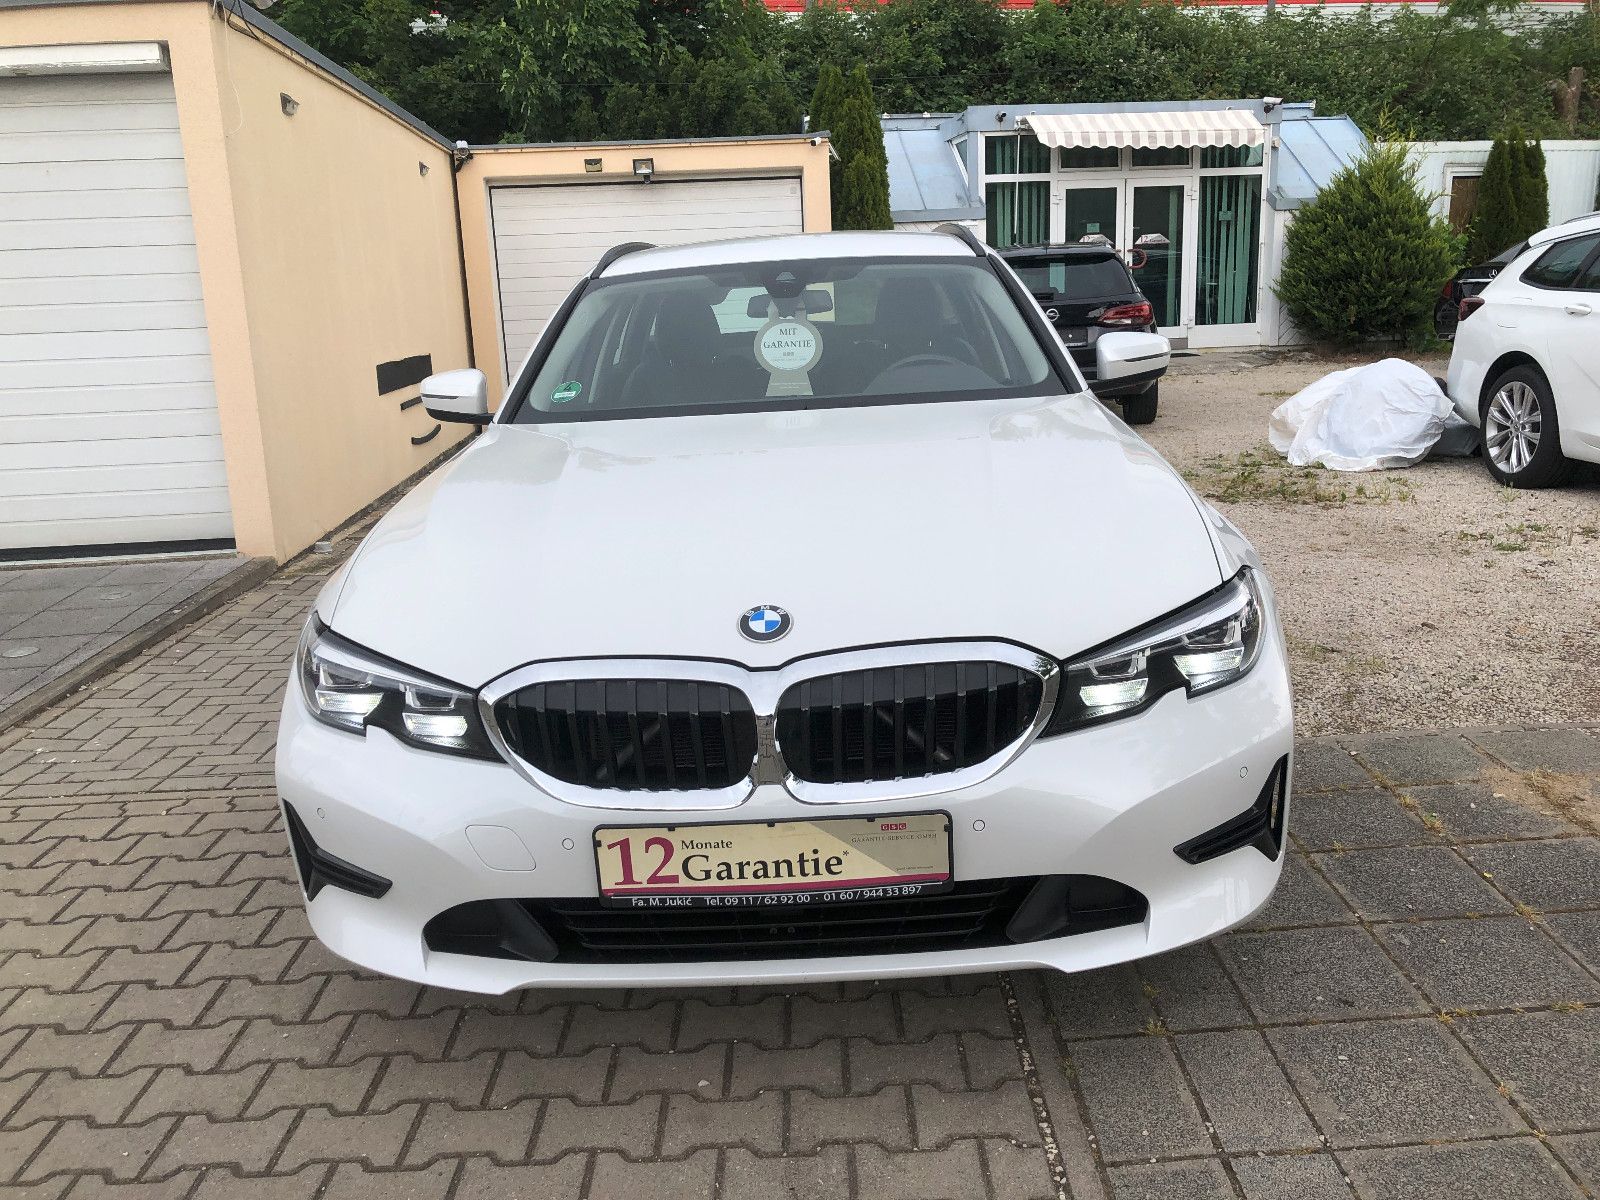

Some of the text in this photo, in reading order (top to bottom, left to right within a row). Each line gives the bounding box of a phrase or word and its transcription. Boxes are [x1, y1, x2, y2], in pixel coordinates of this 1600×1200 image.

[779, 327, 798, 336] MIT
[763, 339, 813, 348] GARANTIE
[744, 605, 787, 617] BMW
[681, 840, 733, 850] Monate
[607, 836, 680, 886] 12
[632, 898, 647, 906] Fa.
[649, 898, 662, 906] M.
[704, 897, 722, 906] Tel.
[724, 896, 739, 906] 09
[742, 896, 754, 905] 11
[764, 896, 778, 905] 62
[780, 896, 794, 904] 92
[796, 894, 810, 902] 00
[824, 892, 836, 901] 01
[840, 892, 854, 900] 60
[863, 889, 883, 898] 944
[886, 888, 899, 896] 33
[902, 886, 922, 894] 897
